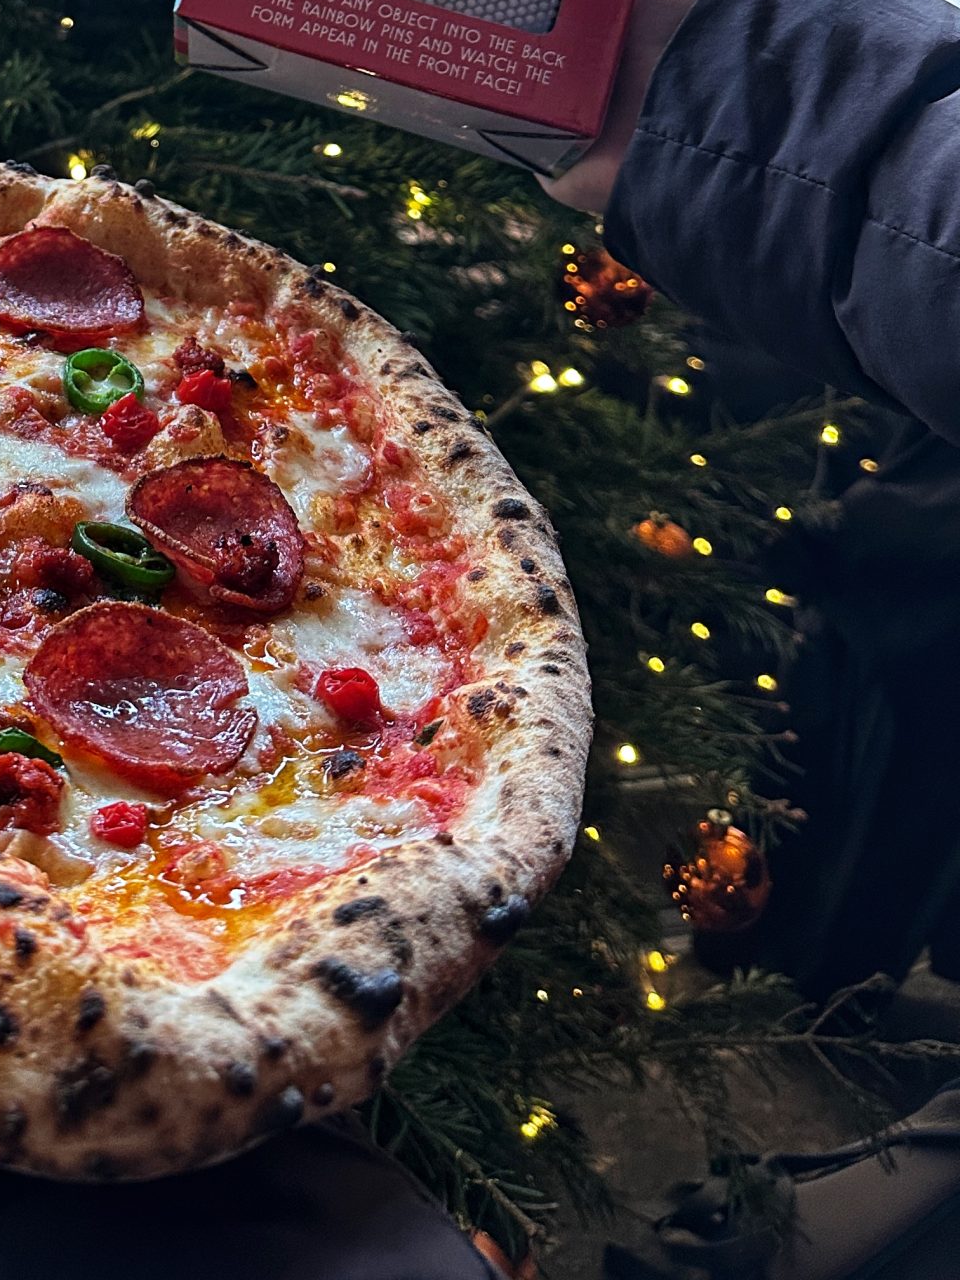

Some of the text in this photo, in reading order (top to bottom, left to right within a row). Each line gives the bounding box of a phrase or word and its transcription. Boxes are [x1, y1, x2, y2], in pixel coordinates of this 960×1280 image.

[251, 5, 523, 96] FORM APPEAR IN THE FRONT FACE!
[302, 1, 375, 33] RAINBOW
[381, 23, 415, 45] PINS
[418, 36, 453, 55] AND
[460, 46, 517, 74] WATCH
[525, 64, 553, 85] THE
[378, 4, 438, 31] OBJECT
[443, 22, 481, 44] INTO
[489, 34, 516, 54] THE
[521, 44, 566, 69] BACK
